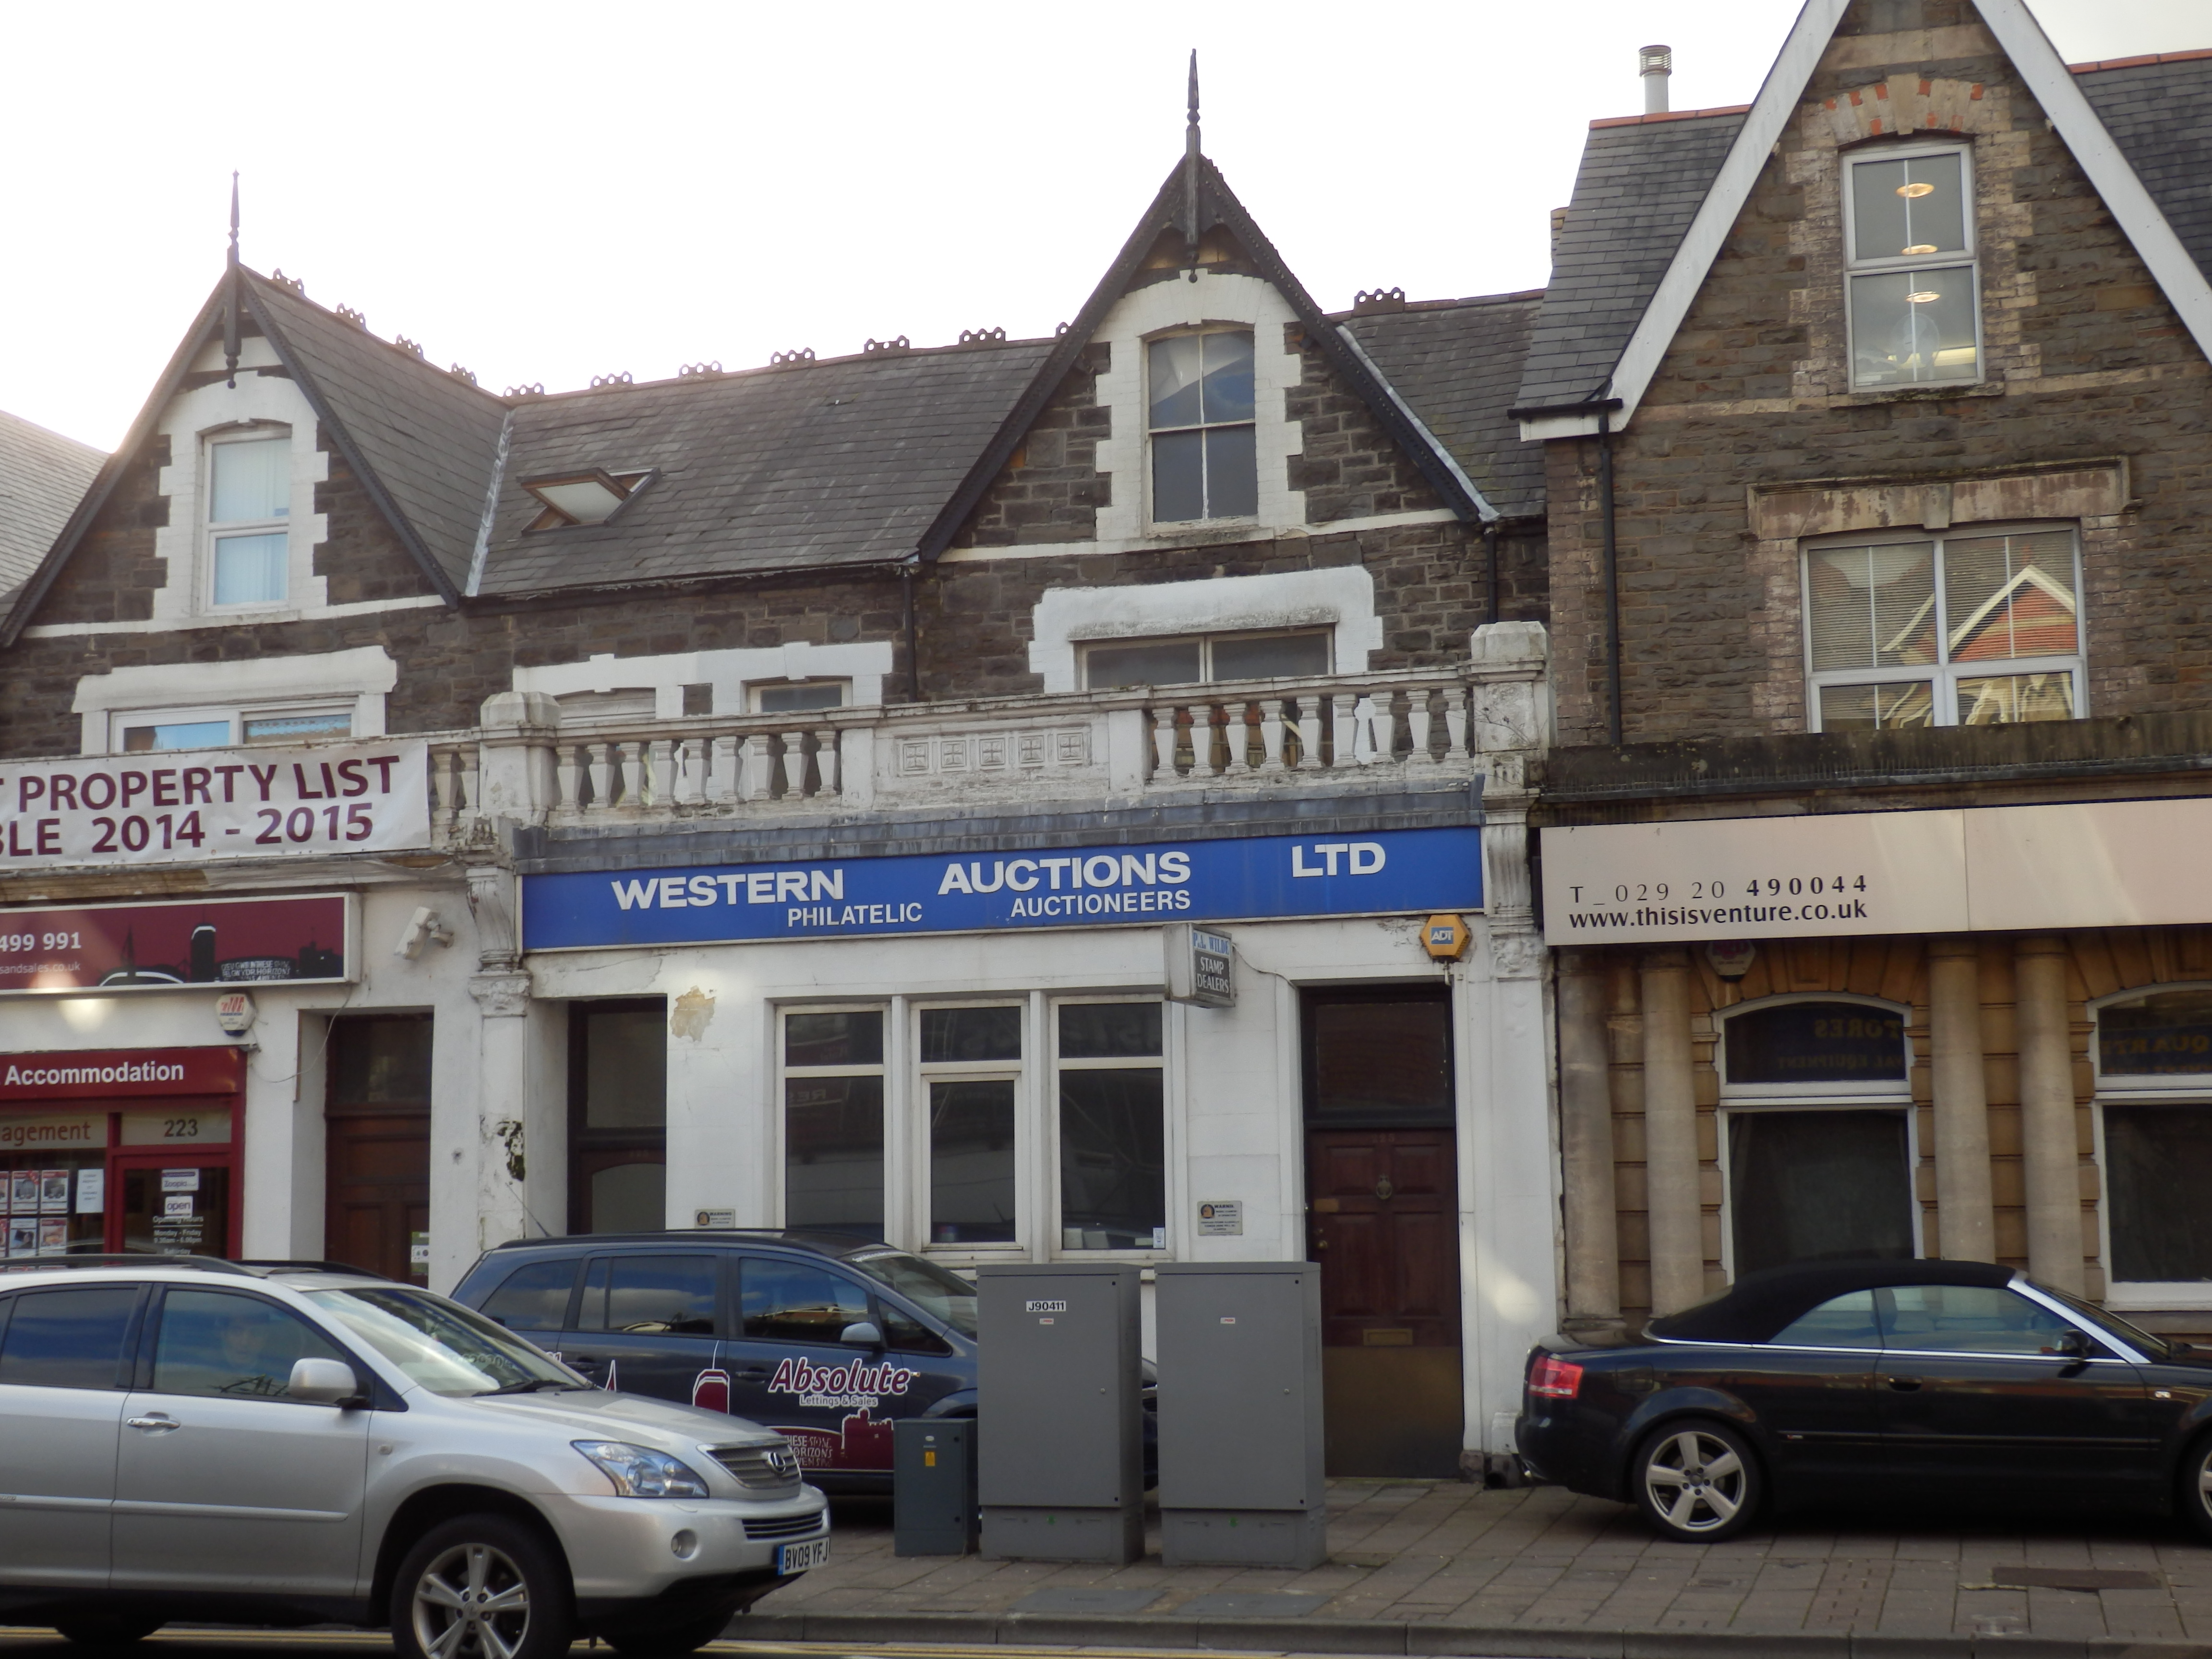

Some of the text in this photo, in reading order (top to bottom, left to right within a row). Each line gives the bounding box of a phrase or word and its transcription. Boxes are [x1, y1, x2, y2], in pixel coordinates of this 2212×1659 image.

[19, 755, 399, 813] PROPERTY LIST
[0, 818, 62, 857] LE
[92, 810, 205, 853] 2014
[255, 802, 373, 845] 2015
[612, 842, 1386, 910] WESTERN AUCTIONS LTD
[1746, 875, 1866, 896] 490044
[788, 890, 1190, 927] PHILATELIC AUCTIONEERS
[1569, 899, 1868, 928] www.thisisventure.co.uk
[0, 932, 82, 952] 499 991
[1209, 937, 1229, 955] WILDE
[1431, 930, 1454, 941] ADT
[1201, 956, 1224, 975] STAMP
[1197, 973, 1229, 994] DEALERS
[4, 1060, 184, 1086] Accommodation
[1, 1121, 91, 1147] agement
[164, 1118, 198, 1138] 223
[167, 1202, 191, 1212] open
[1029, 1301, 1064, 1310] J90411
[768, 1356, 911, 1395] Absolute
[799, 1394, 878, 1408] Lettings & Sales
[793, 1447, 833, 1458] ORIZONS
[785, 1540, 828, 1570] BV09 YFJ
